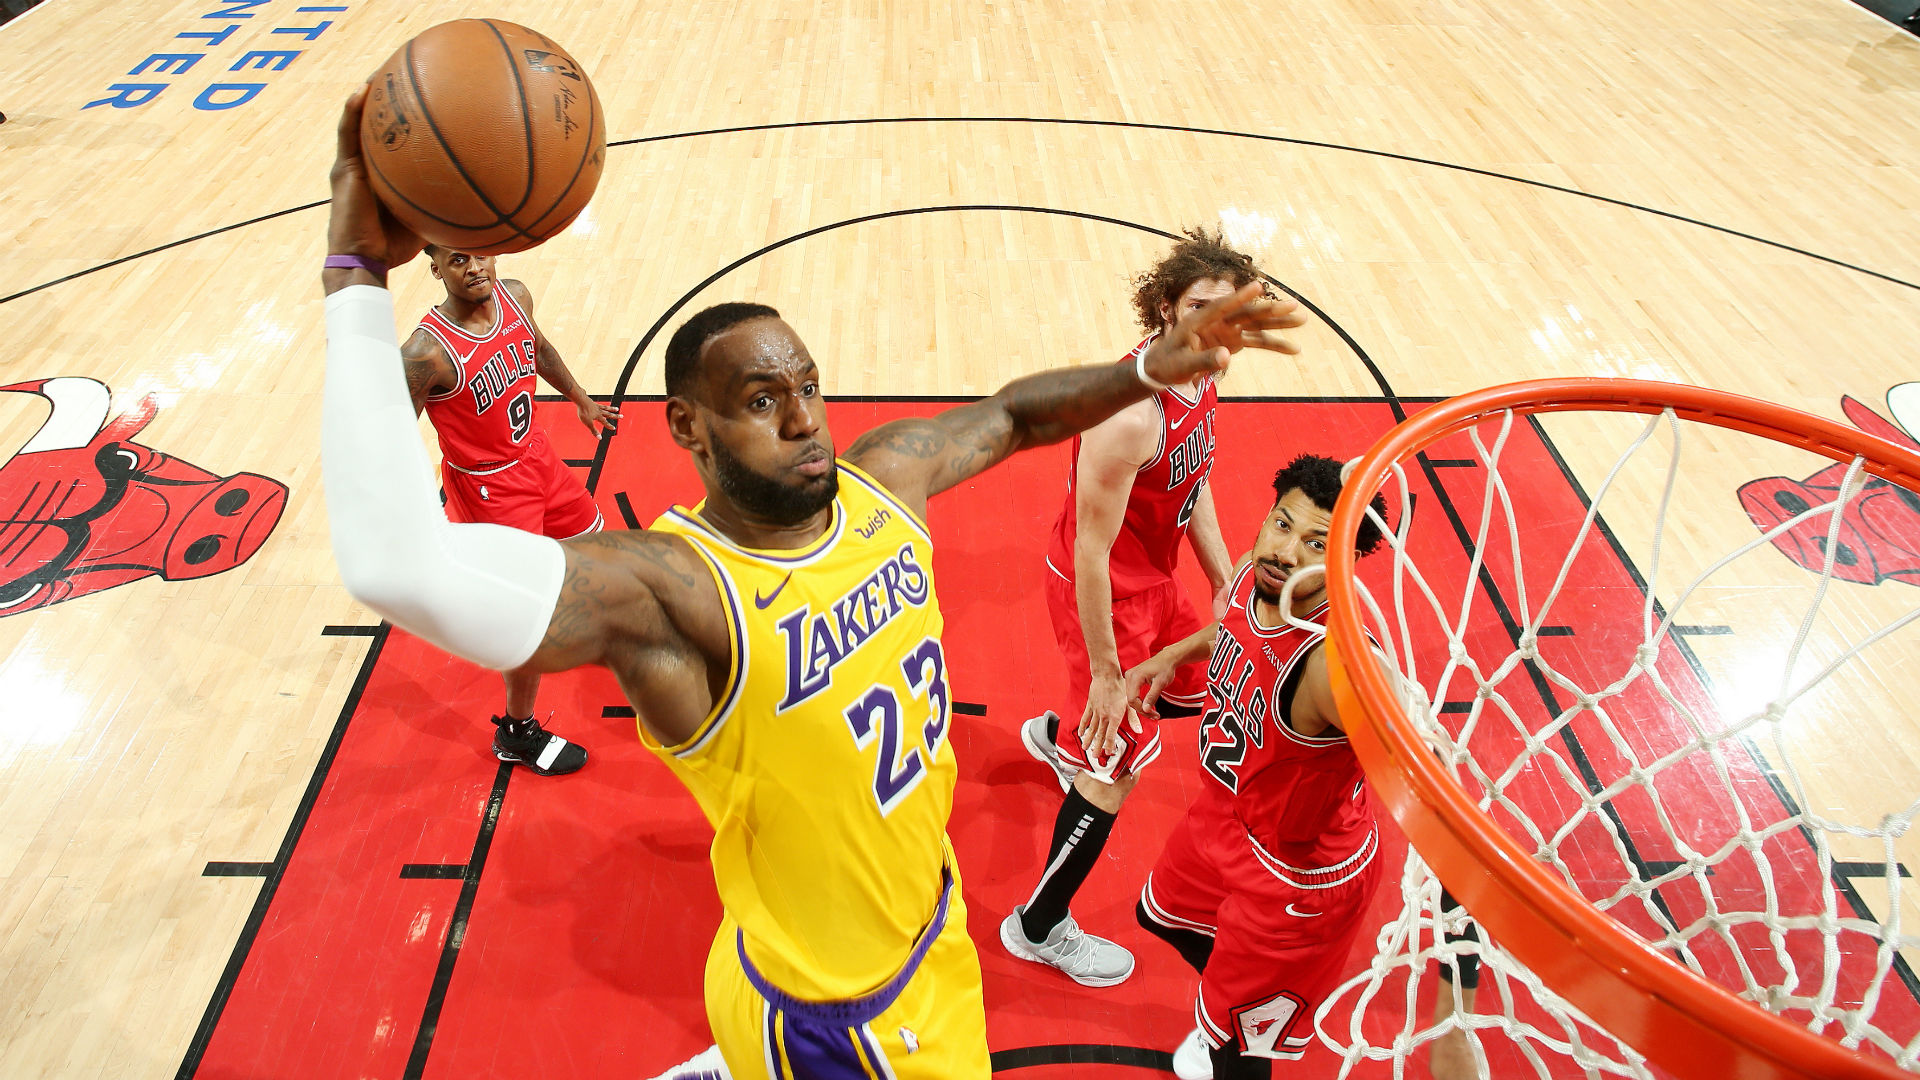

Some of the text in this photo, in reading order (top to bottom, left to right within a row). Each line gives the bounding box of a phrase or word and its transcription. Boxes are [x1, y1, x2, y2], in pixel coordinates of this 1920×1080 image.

[468, 339, 536, 416] BULLS
[507, 390, 533, 444] 9
[1167, 407, 1216, 491] BULL
[855, 508, 891, 540] wish
[1177, 456, 1214, 534] 4
[775, 541, 929, 717] LAKERS
[841, 634, 950, 819] 23
[1207, 622, 1267, 750] ULLS
[1199, 681, 1247, 796] 22
